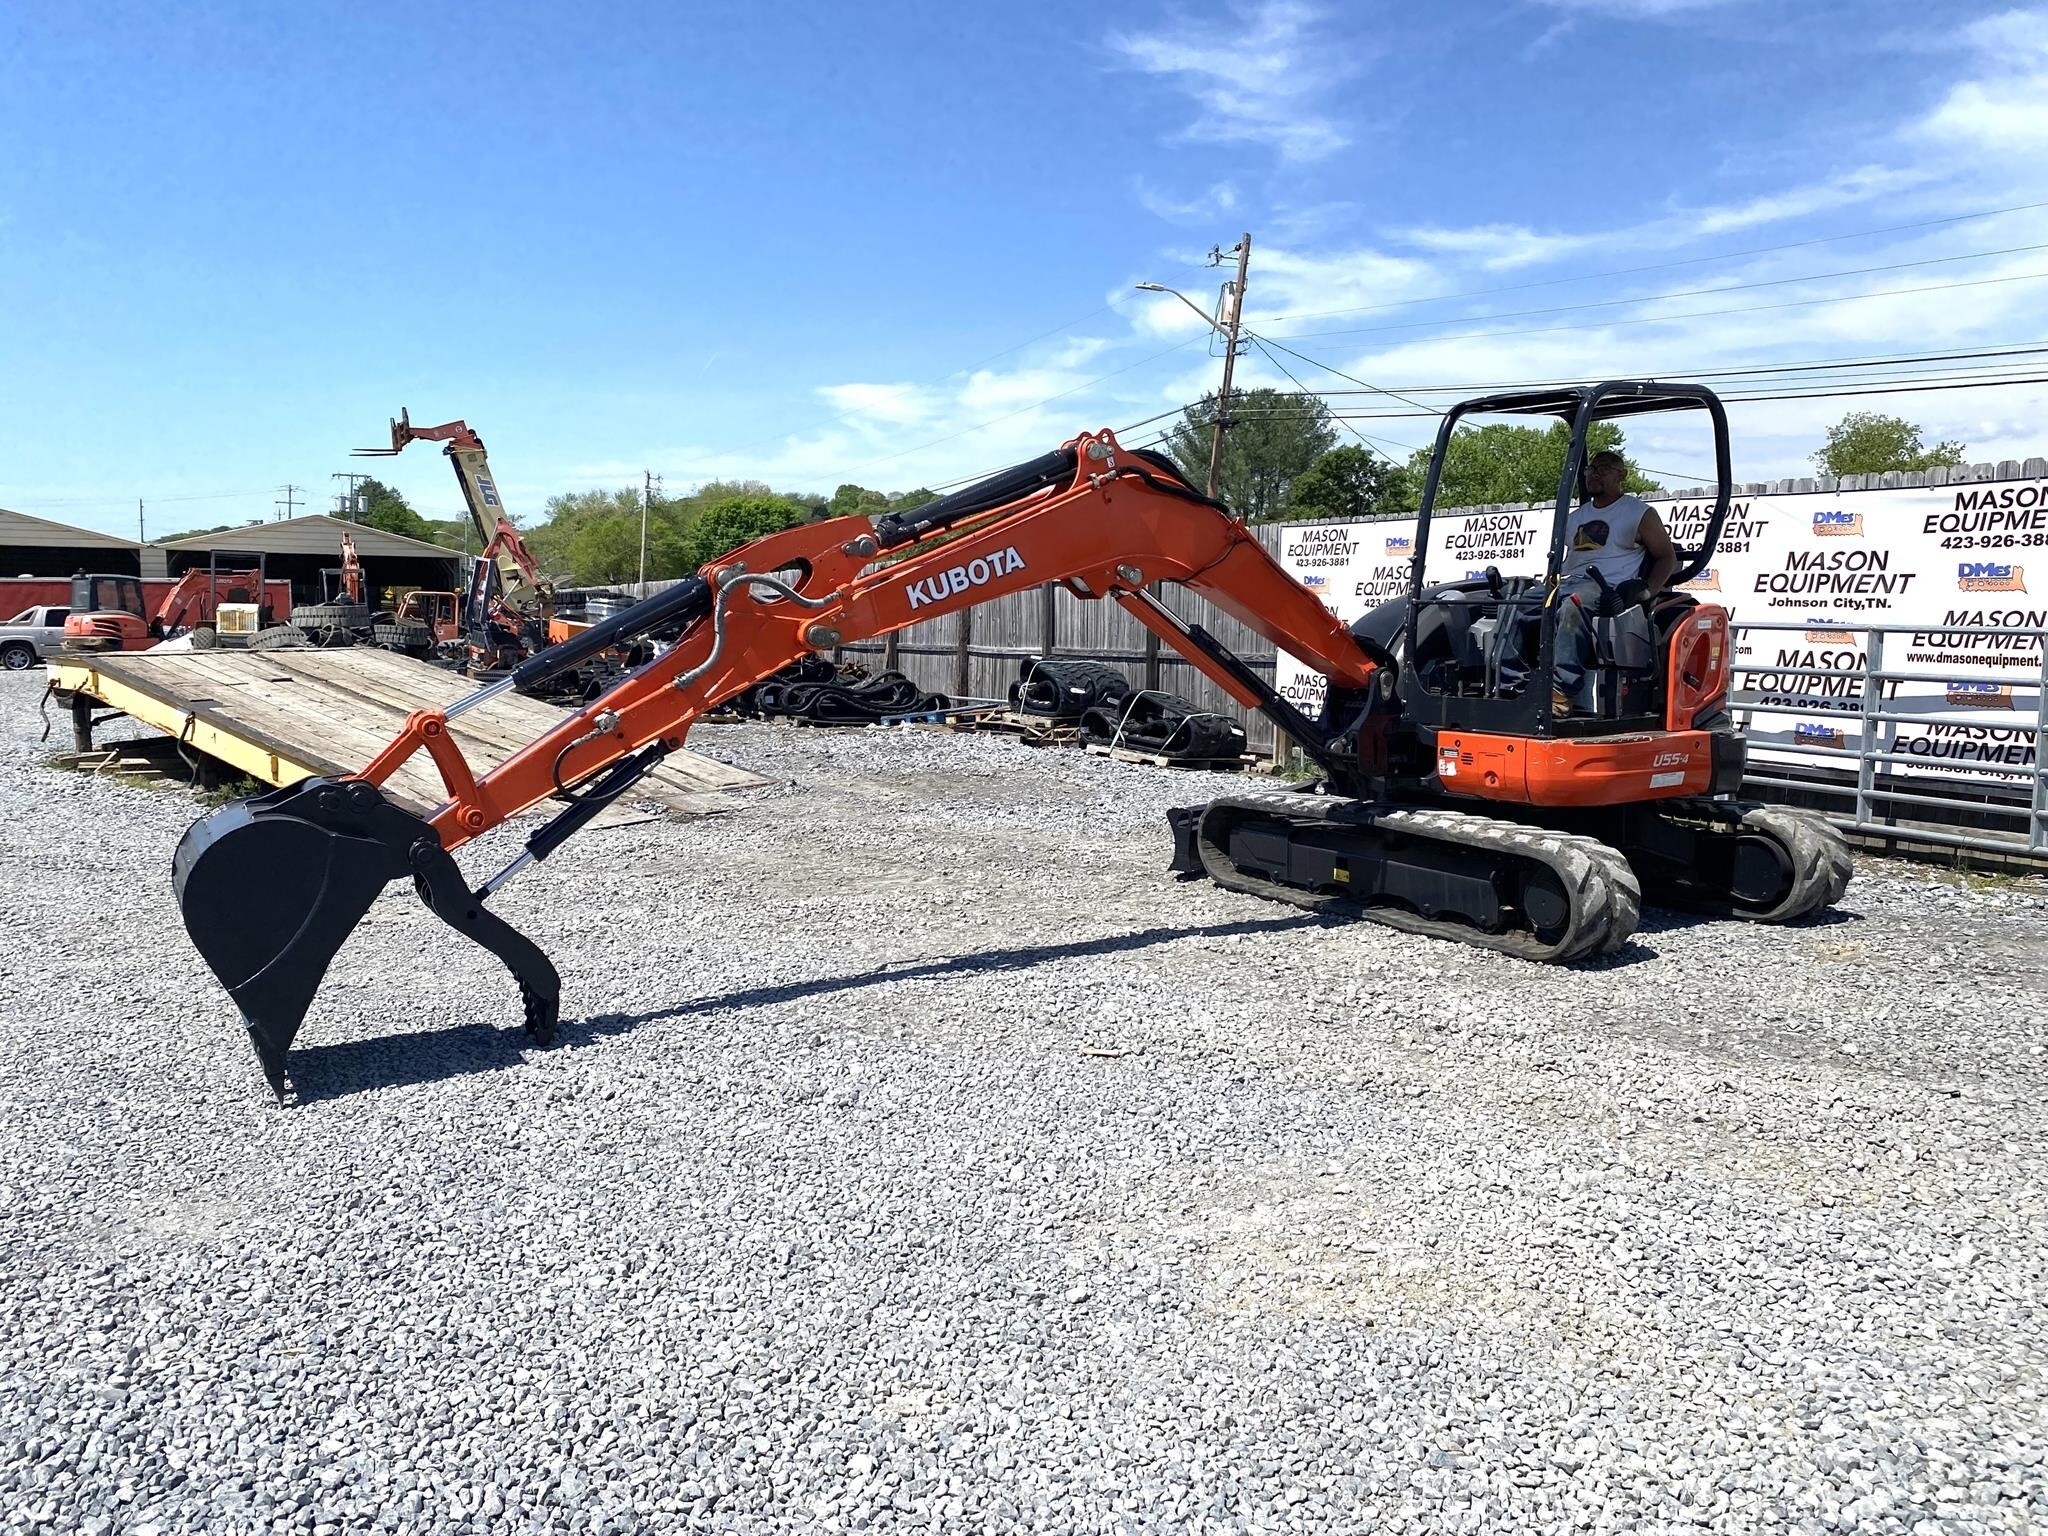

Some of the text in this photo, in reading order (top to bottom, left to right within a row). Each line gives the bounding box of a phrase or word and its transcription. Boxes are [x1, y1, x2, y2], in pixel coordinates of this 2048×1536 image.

[475, 474, 500, 507] JLG
[1669, 503, 1750, 522] MASN
[1923, 509, 2048, 534] EQUIPME
[1464, 515, 1523, 532] MASON
[1302, 529, 1348, 543] MASON
[1445, 530, 1537, 549] EQUIPMENT
[1941, 533, 2048, 549] 423-926-38
[1288, 542, 1359, 557] EQUIPMENT
[1455, 549, 1525, 560] 423-926-3881
[1296, 558, 1349, 567] 423-926-3881
[1785, 550, 1889, 571] MASON
[905, 545, 1026, 610] KUBOTA
[1754, 573, 1916, 594] EQUIPMENT
[1768, 597, 1892, 610] Johnson City,TN.
[1943, 610, 2047, 628] MASON
[1912, 632, 2045, 650] EQUIPMEN
[1907, 652, 2042, 668] www.dmasonequipment.
[1294, 673, 1328, 688] MASO
[1743, 672, 1904, 700] EQUIPMET
[1280, 686, 1325, 701] EQUIPM
[1890, 736, 2036, 766] EQUIPMEN
